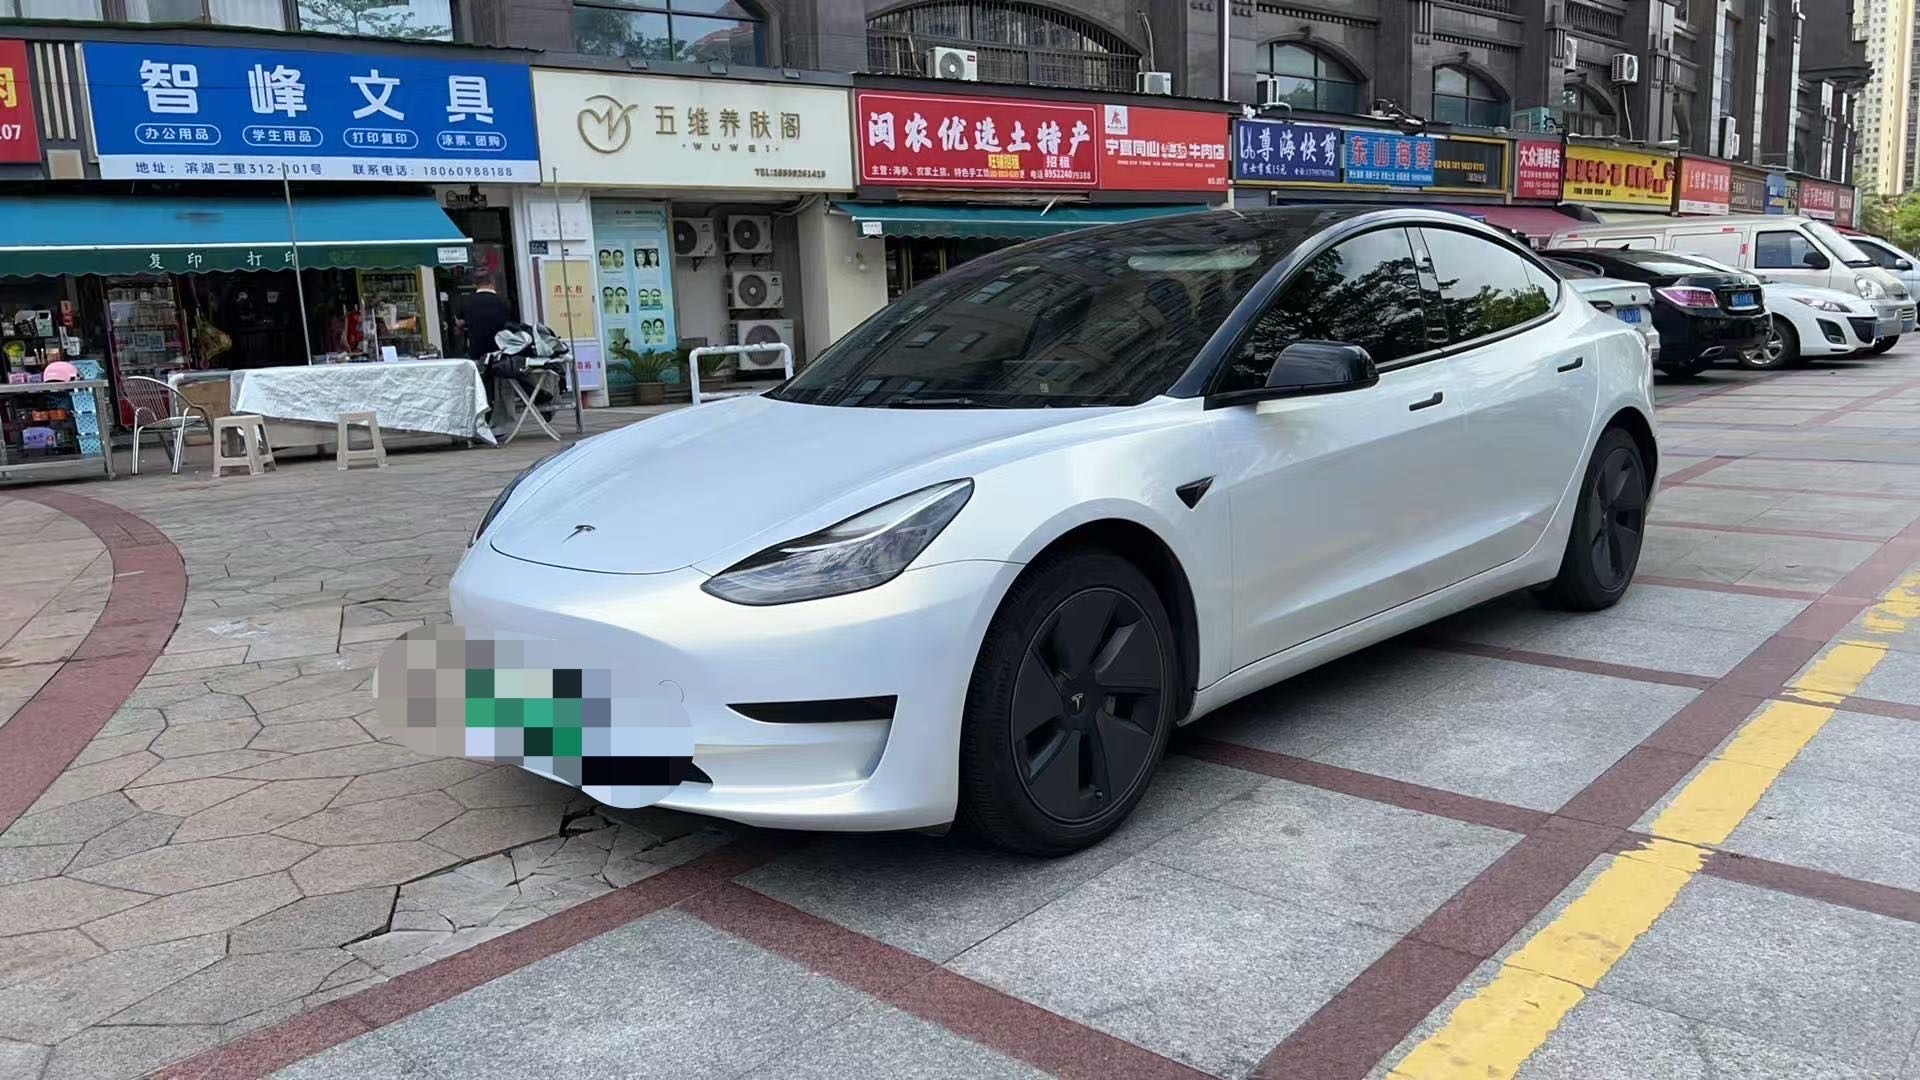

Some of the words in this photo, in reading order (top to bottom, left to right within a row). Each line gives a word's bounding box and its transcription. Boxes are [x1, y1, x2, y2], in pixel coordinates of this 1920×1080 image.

[140, 60, 494, 124] 智峰文具
[653, 105, 801, 141] 五维养肤阁
[868, 110, 1091, 157] 闽农优选土特产
[145, 128, 209, 141] 办公用品
[252, 130, 311, 143] 学生用品
[352, 132, 407, 145] 打印复印
[441, 134, 501, 147] 泳票、团购
[1257, 127, 1337, 166] 尊海快剪
[1350, 135, 1432, 171] 东山海鲜
[1519, 145, 1561, 169] 大众海鲜店
[1046, 155, 1071, 169] 招租
[148, 252, 202, 270] 复印
